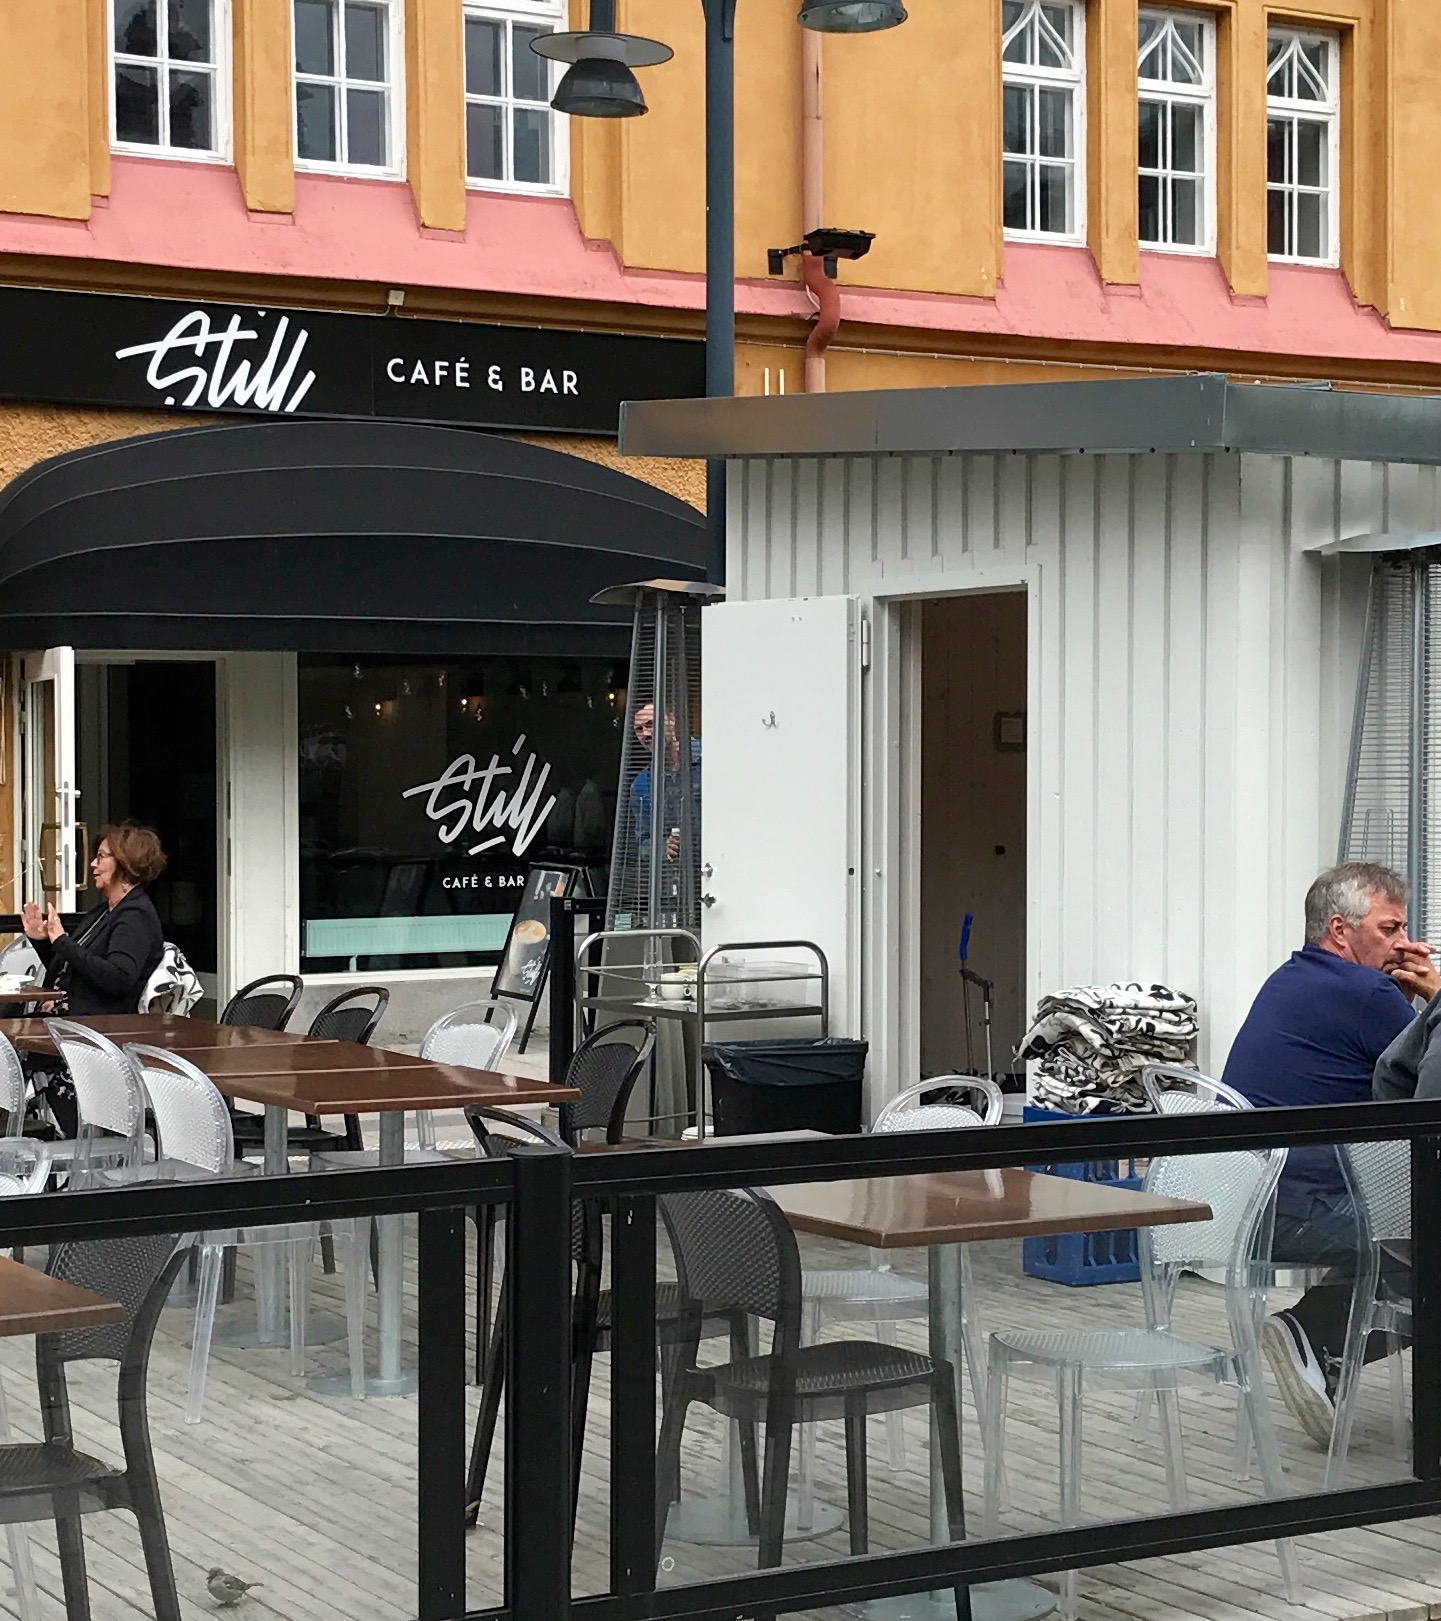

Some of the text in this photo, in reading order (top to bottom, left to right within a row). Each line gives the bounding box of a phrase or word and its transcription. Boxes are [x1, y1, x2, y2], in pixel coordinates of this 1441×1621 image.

[115, 310, 579, 412] Still CAFÉ & BAR
[402, 733, 557, 857] Still
[442, 873, 525, 889] CAFÉ & BAR
